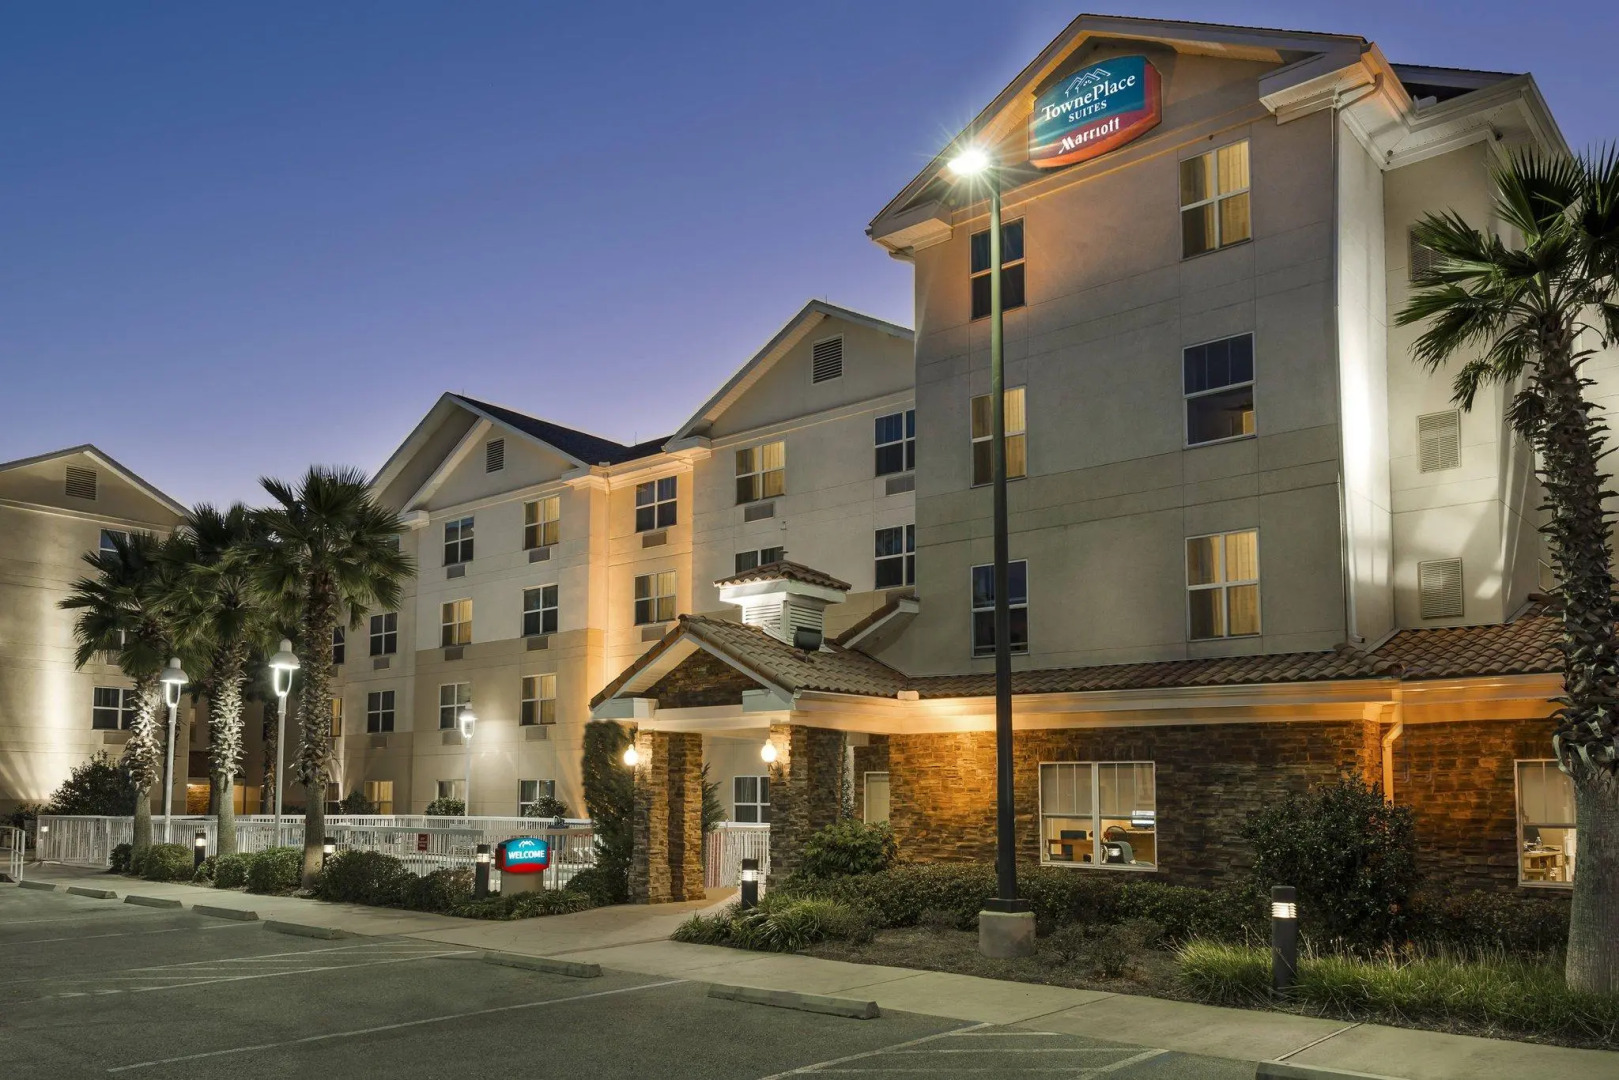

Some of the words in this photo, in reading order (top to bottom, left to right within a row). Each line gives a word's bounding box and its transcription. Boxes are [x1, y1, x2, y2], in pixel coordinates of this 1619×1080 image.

[1042, 75, 1136, 121] TownePlace
[1068, 100, 1107, 122] SUITES
[1058, 117, 1121, 154] Marriott
[508, 850, 545, 860] WELCOME
